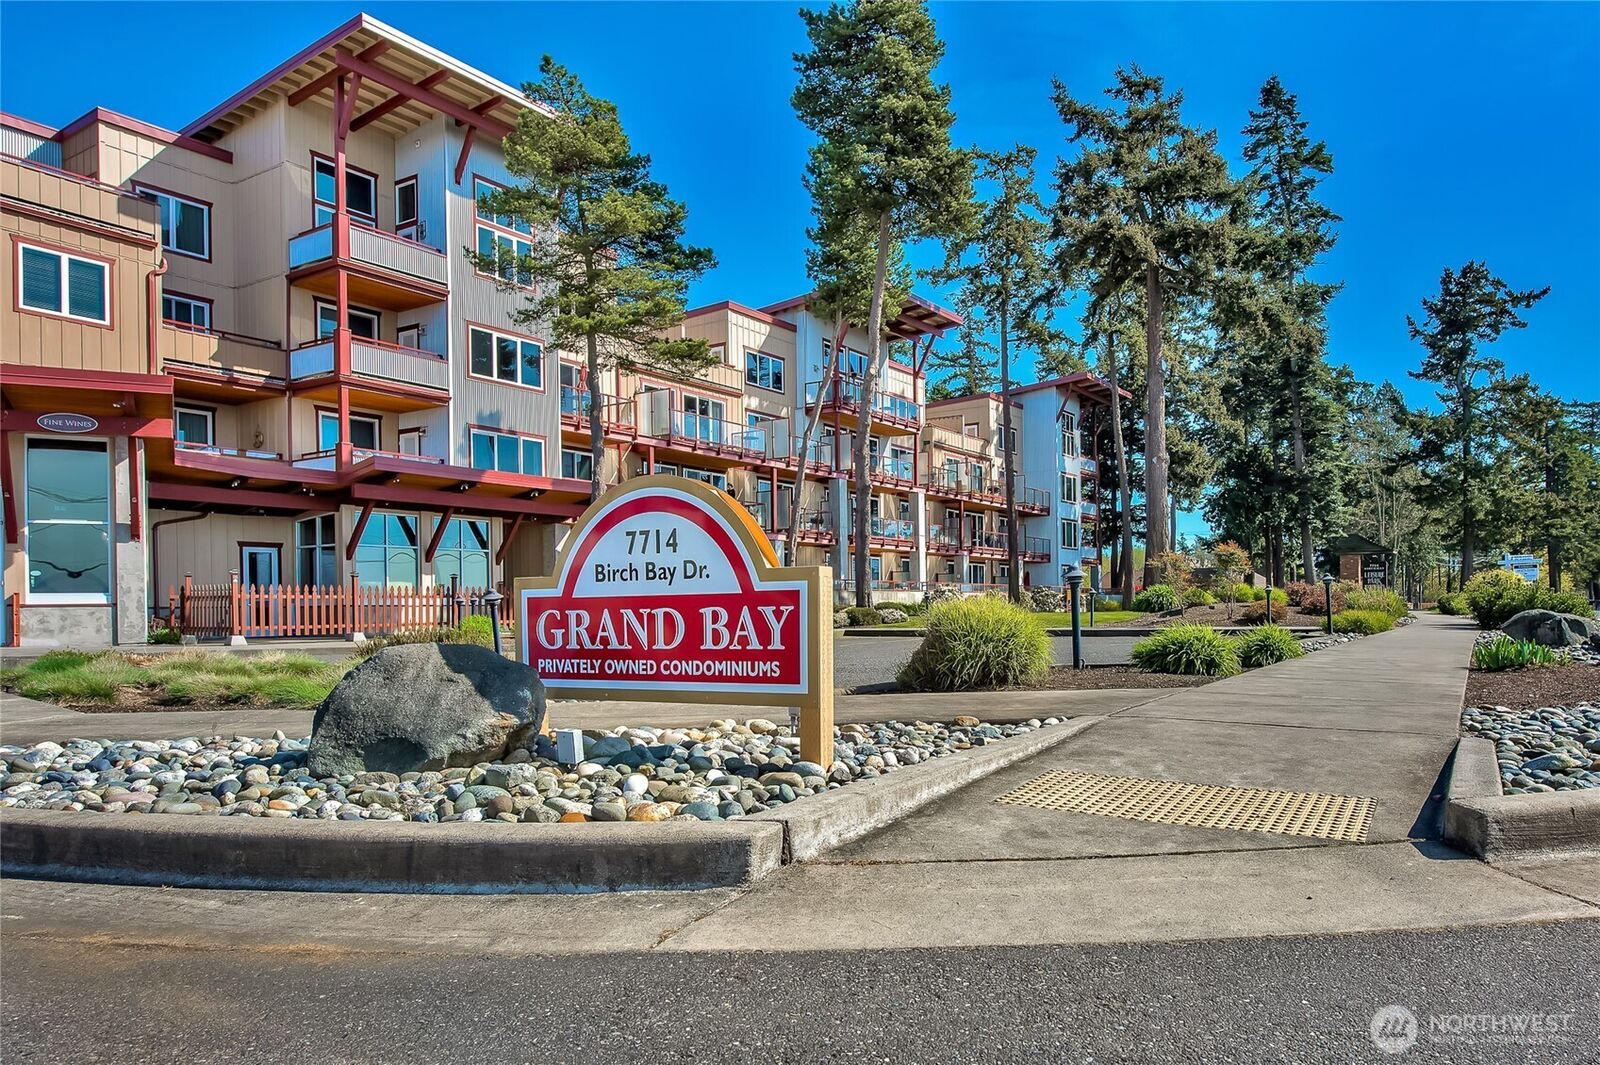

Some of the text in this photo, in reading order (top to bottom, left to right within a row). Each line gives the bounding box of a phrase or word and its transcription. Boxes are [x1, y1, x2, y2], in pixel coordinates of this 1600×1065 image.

[44, 418, 92, 428] FINE WINES
[625, 527, 678, 555] 7714
[594, 559, 710, 585] Birch Bay Dr.
[535, 605, 794, 650] GRAND BAY
[538, 658, 780, 677] PRIVATELY OWNED CONDOMINIUMS
